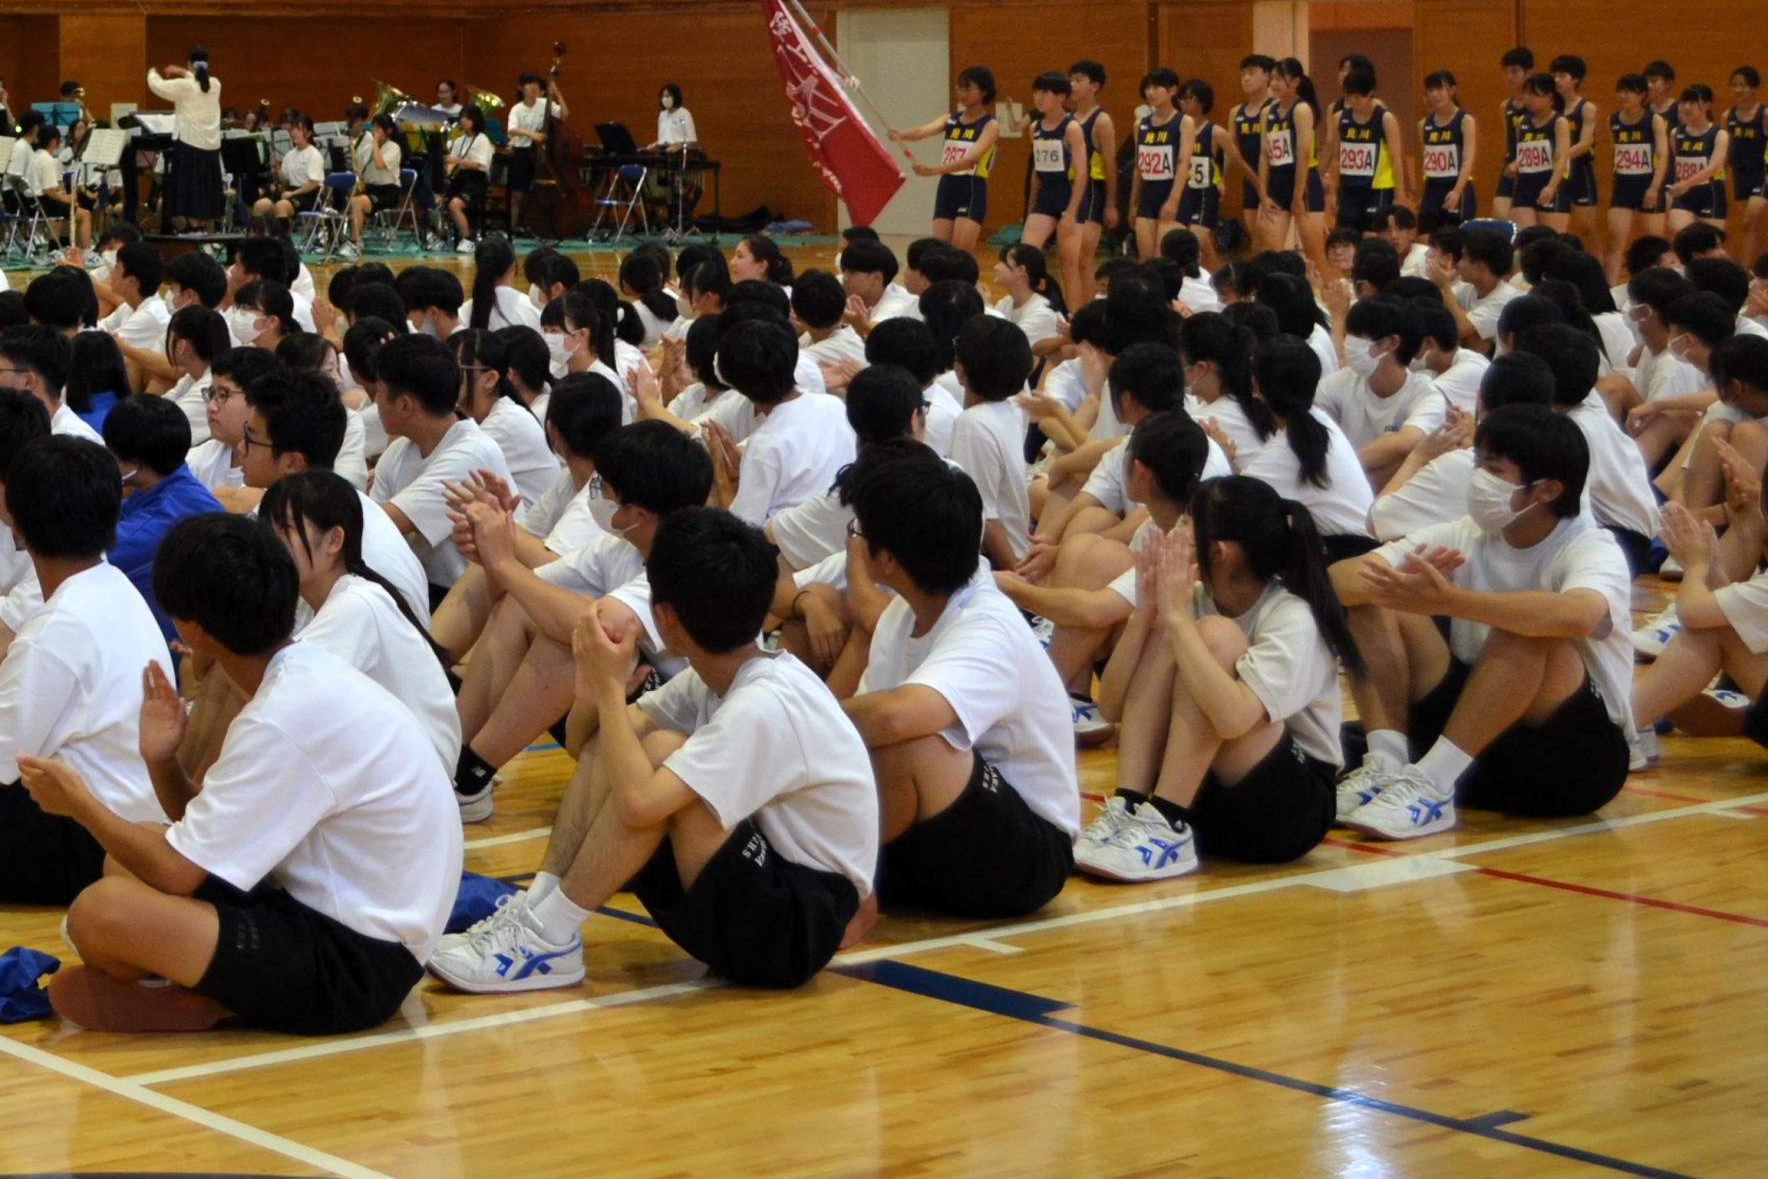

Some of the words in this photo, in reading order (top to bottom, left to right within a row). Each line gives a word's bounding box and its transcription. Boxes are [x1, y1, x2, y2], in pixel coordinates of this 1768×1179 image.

[1036, 149, 1059, 163] 276
[1138, 151, 1171, 174] 292A
[1341, 147, 1372, 170] 293A
[1424, 151, 1456, 172] 290A
[1518, 146, 1550, 168] 289A
[1616, 149, 1650, 169] 294A
